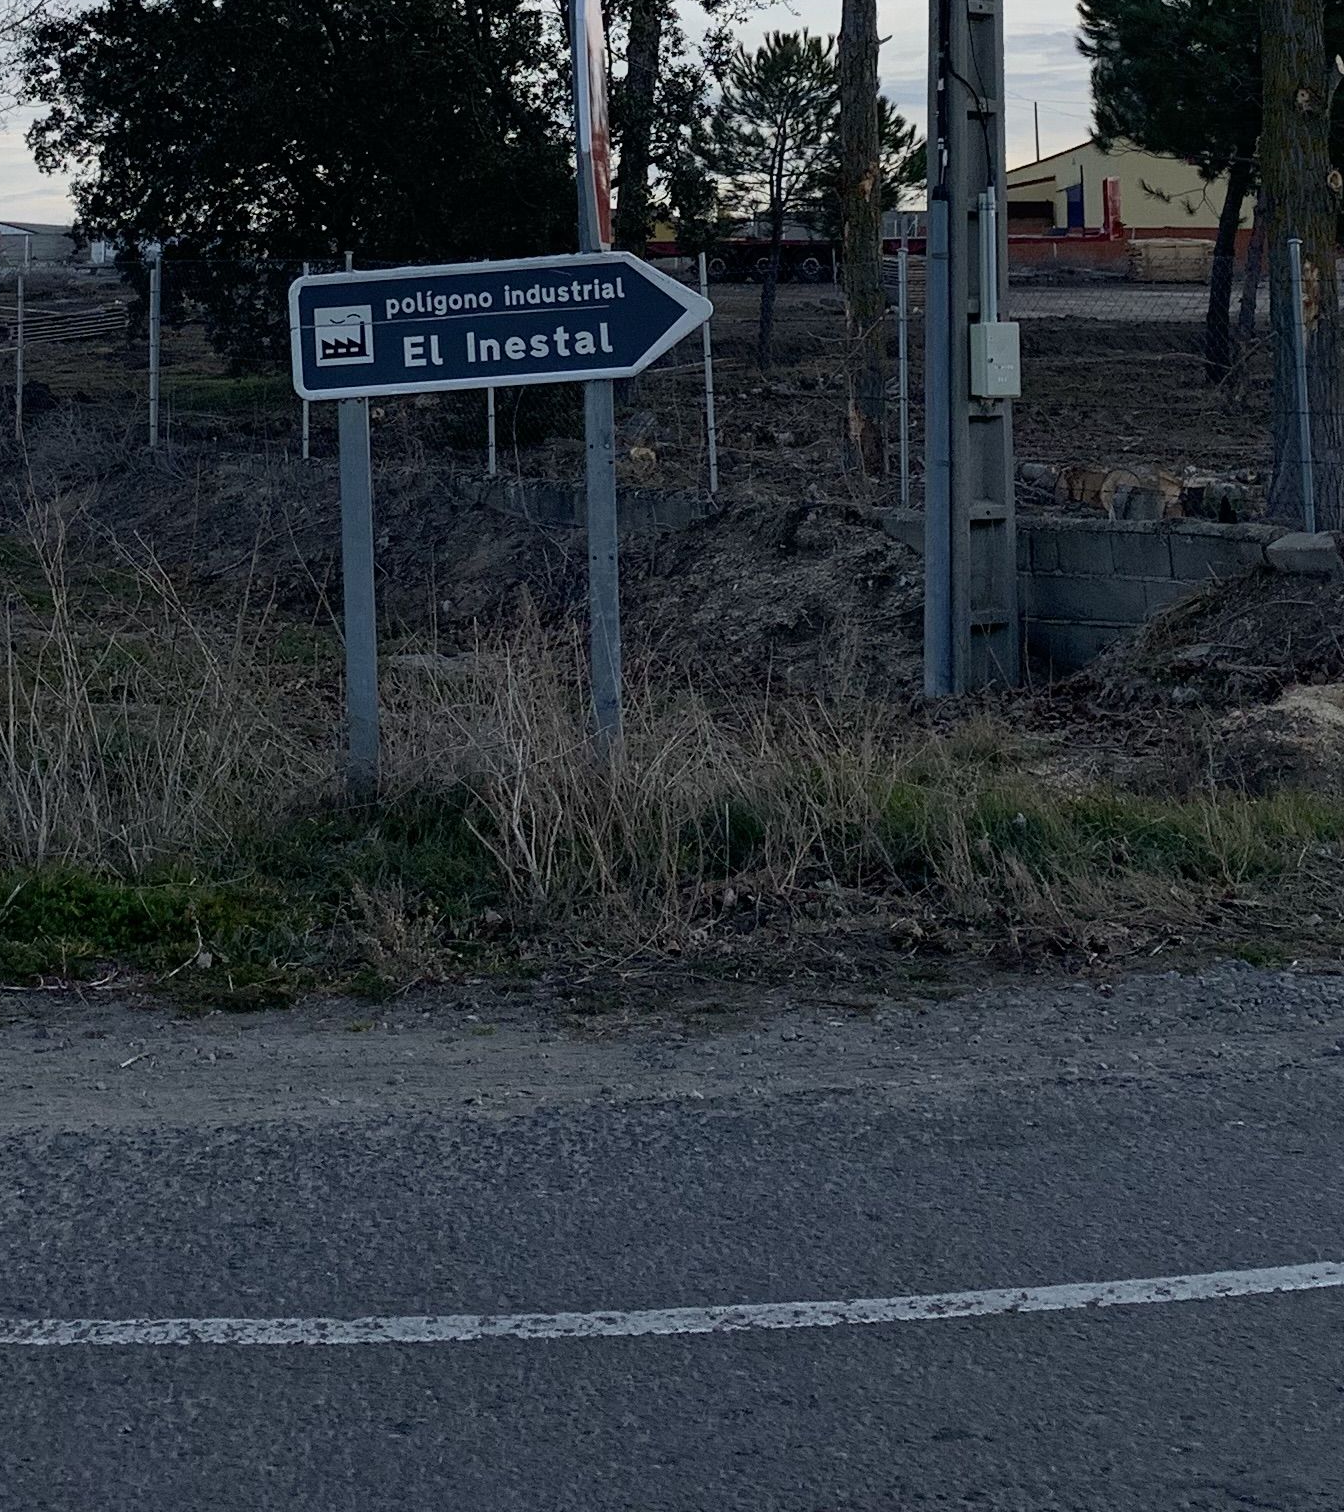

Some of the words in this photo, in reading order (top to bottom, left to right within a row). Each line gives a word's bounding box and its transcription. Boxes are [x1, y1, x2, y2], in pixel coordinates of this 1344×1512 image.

[386, 291, 492, 319] polígono
[505, 277, 625, 306] industrial
[404, 335, 443, 367] El
[467, 322, 613, 363] Inestal
